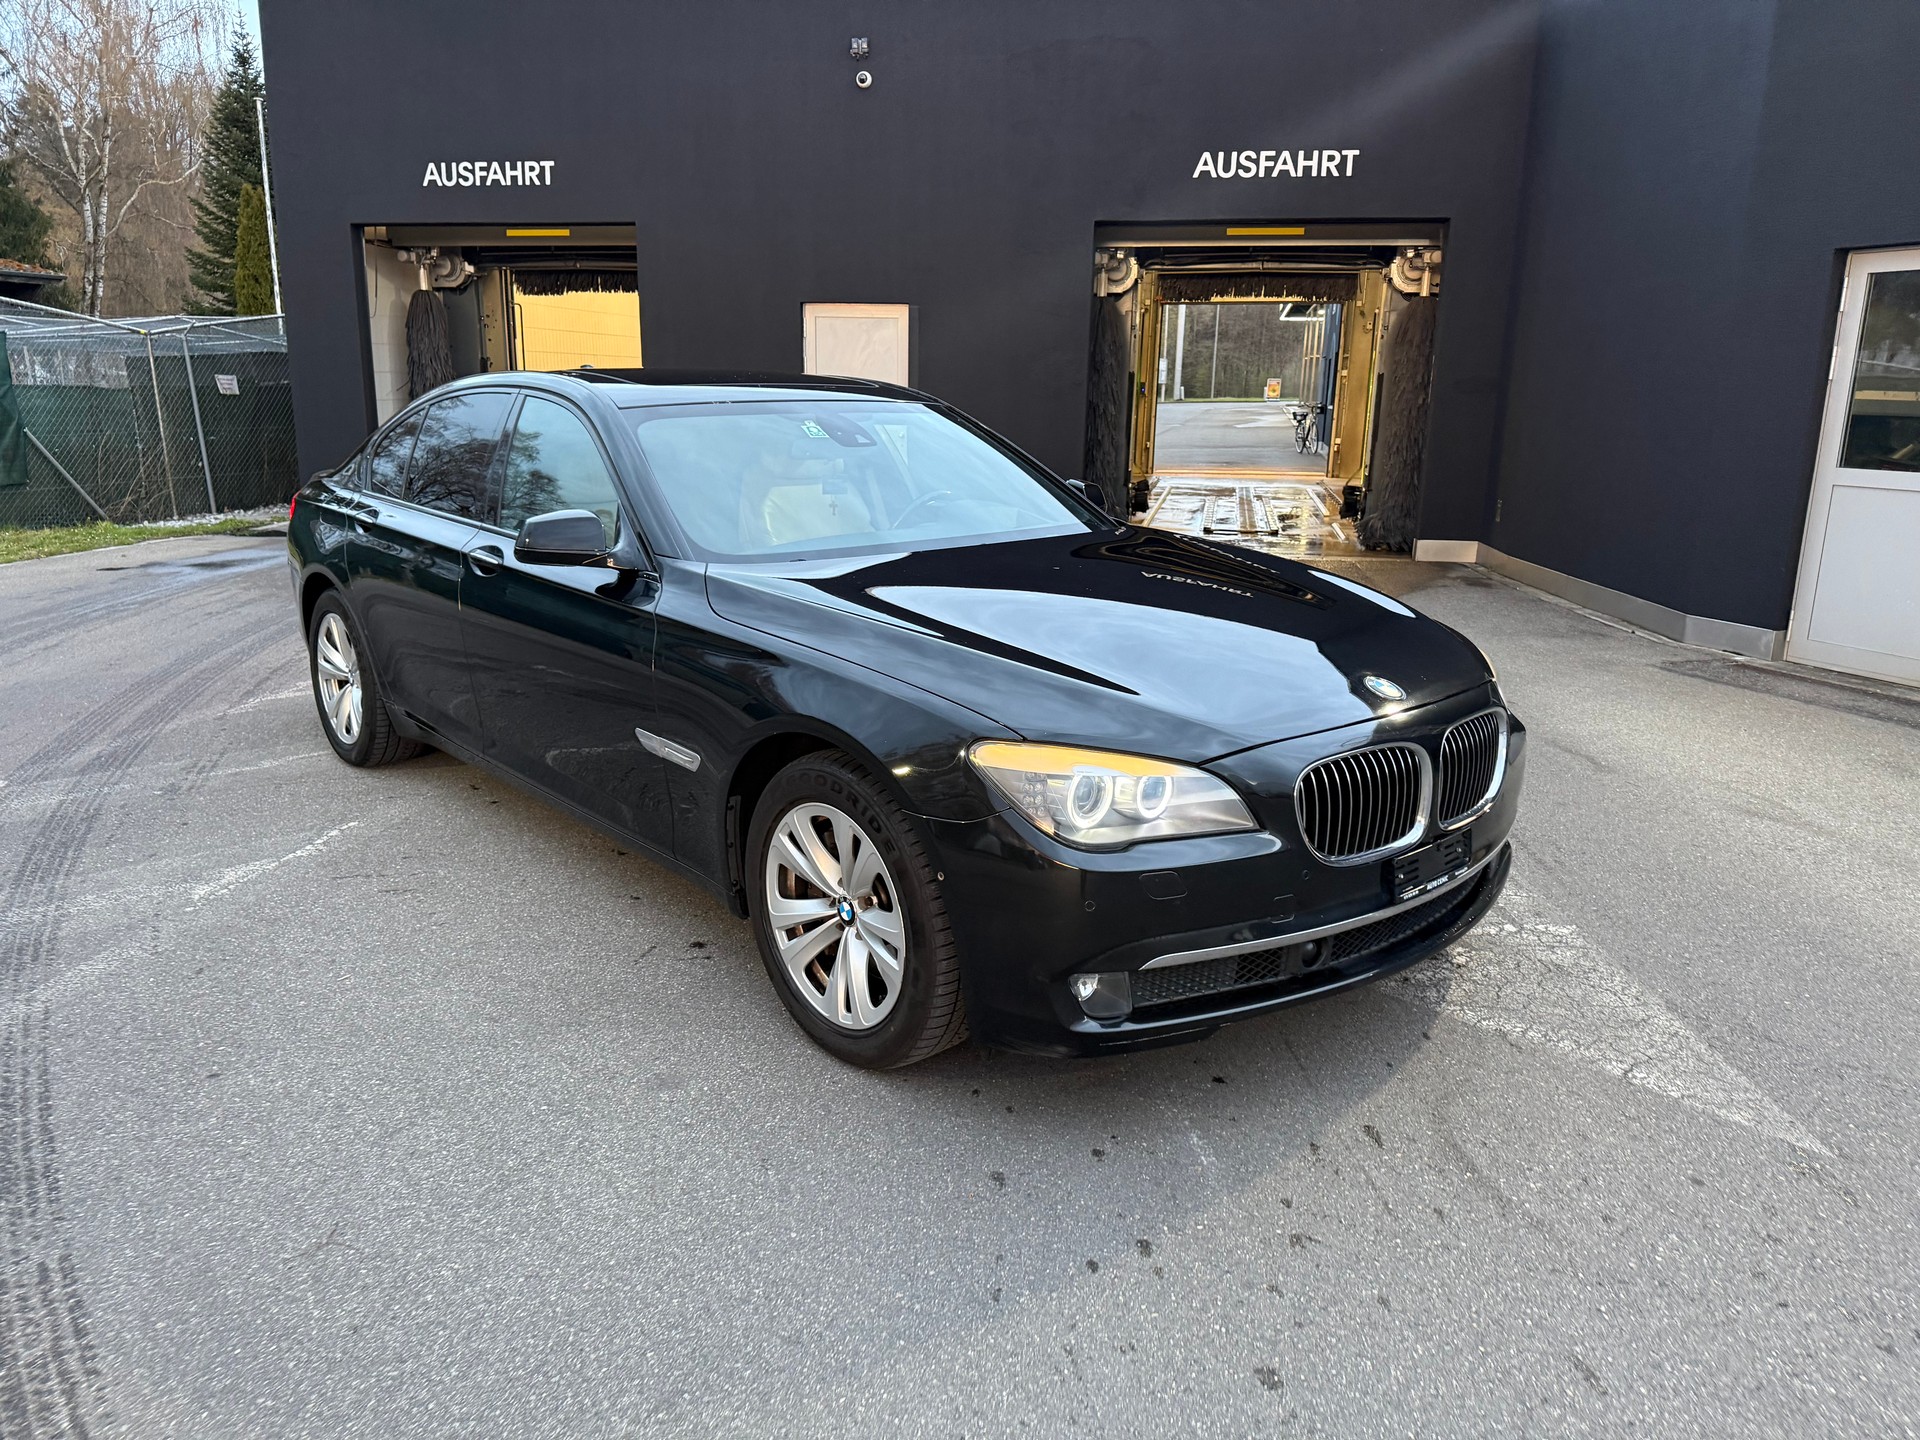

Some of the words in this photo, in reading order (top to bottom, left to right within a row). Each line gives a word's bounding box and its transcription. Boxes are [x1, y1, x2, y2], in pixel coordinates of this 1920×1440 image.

[422, 160, 555, 187] AUSFAHRT
[1193, 149, 1361, 180] AUSFAHRT
[785, 772, 896, 856] GOODRIDE
